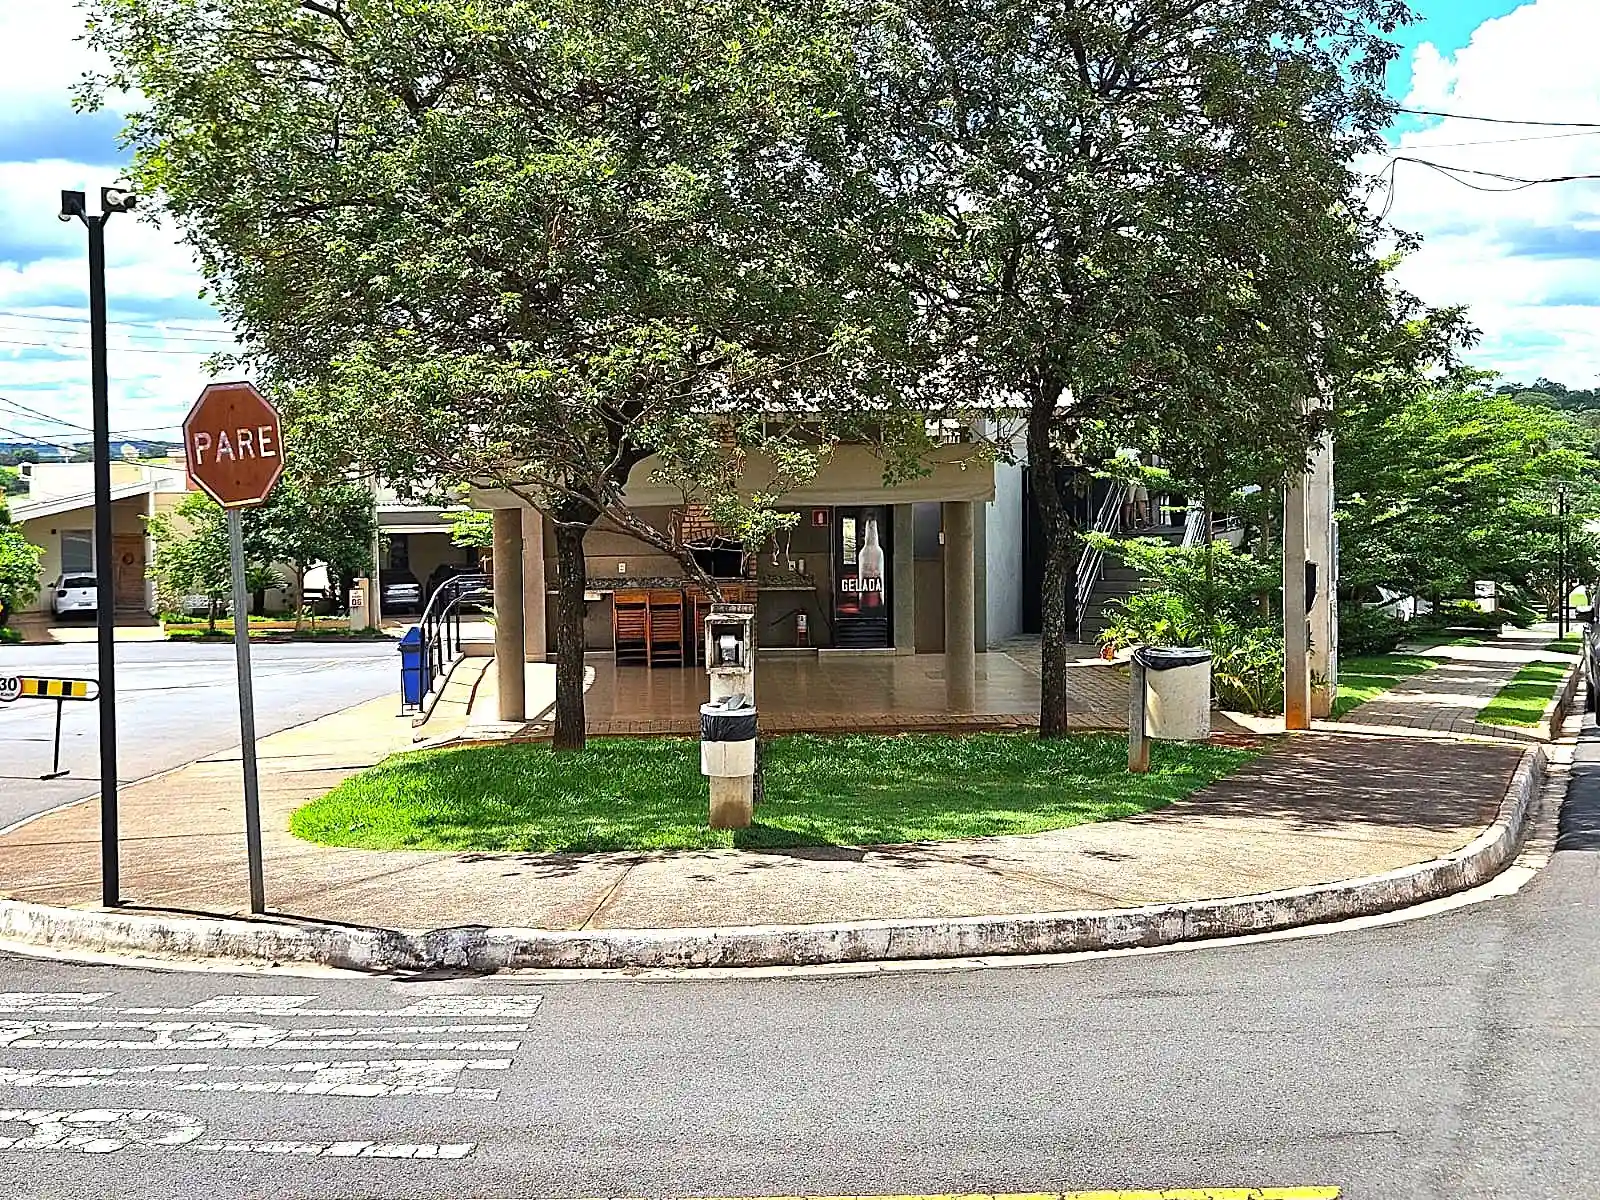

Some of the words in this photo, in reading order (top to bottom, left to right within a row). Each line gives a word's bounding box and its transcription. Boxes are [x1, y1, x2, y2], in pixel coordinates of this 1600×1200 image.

[194, 425, 276, 465] PARE
[842, 578, 882, 592] GELADA
[0, 677, 17, 691] 30
